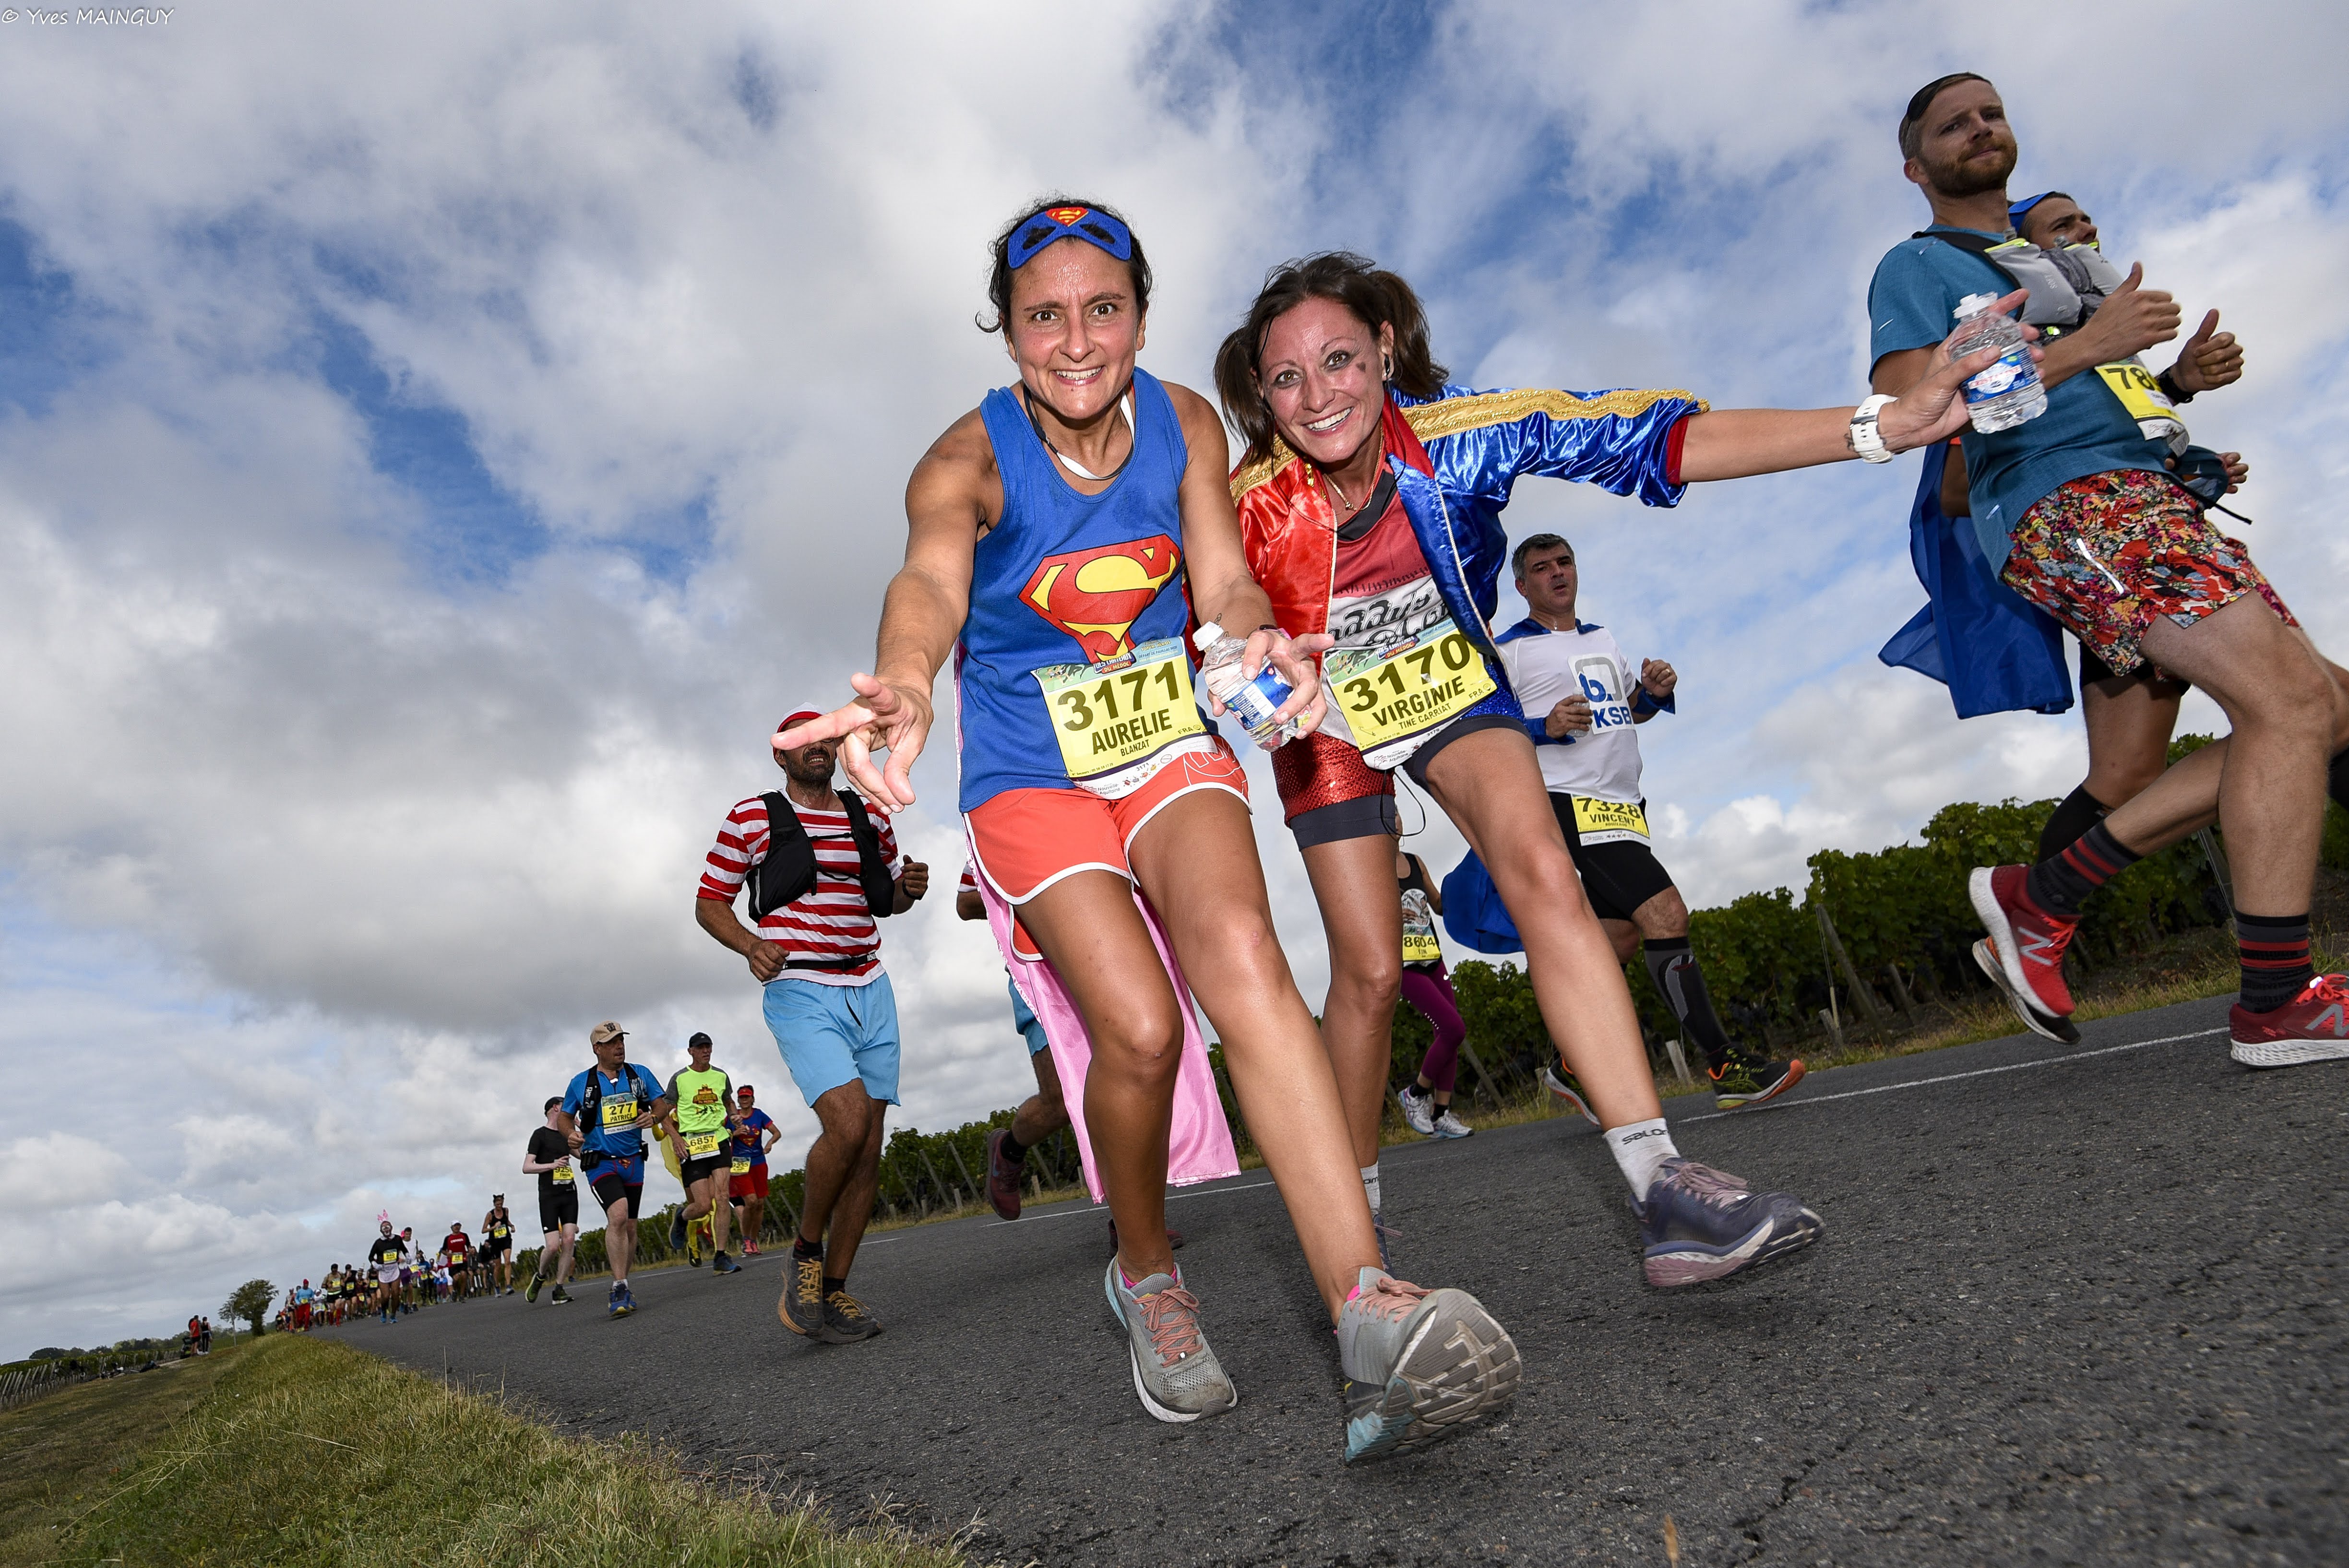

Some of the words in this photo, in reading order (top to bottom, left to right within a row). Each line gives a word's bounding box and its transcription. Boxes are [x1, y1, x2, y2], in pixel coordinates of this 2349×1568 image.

[1344, 634, 1470, 712] 3170
[1057, 662, 1180, 731] 3171
[1372, 676, 1465, 726] VIRGINIE
[1468, 689, 1484, 700] FRA
[1398, 718, 1417, 729] TINE
[1418, 703, 1451, 723] CARRIAT
[1593, 707, 1632, 728] KSB
[1092, 709, 1172, 755] AURELIE
[1427, 728, 1440, 736] 3170
[1121, 739, 1150, 757] BLANZAT
[1136, 762, 1149, 772] 3171
[1576, 797, 1641, 819] 7328
[1589, 814, 1635, 827] VINCENT
[609, 1103, 633, 1116] 277
[610, 1113, 633, 1122] PATRICE
[690, 1135, 715, 1147] 6857
